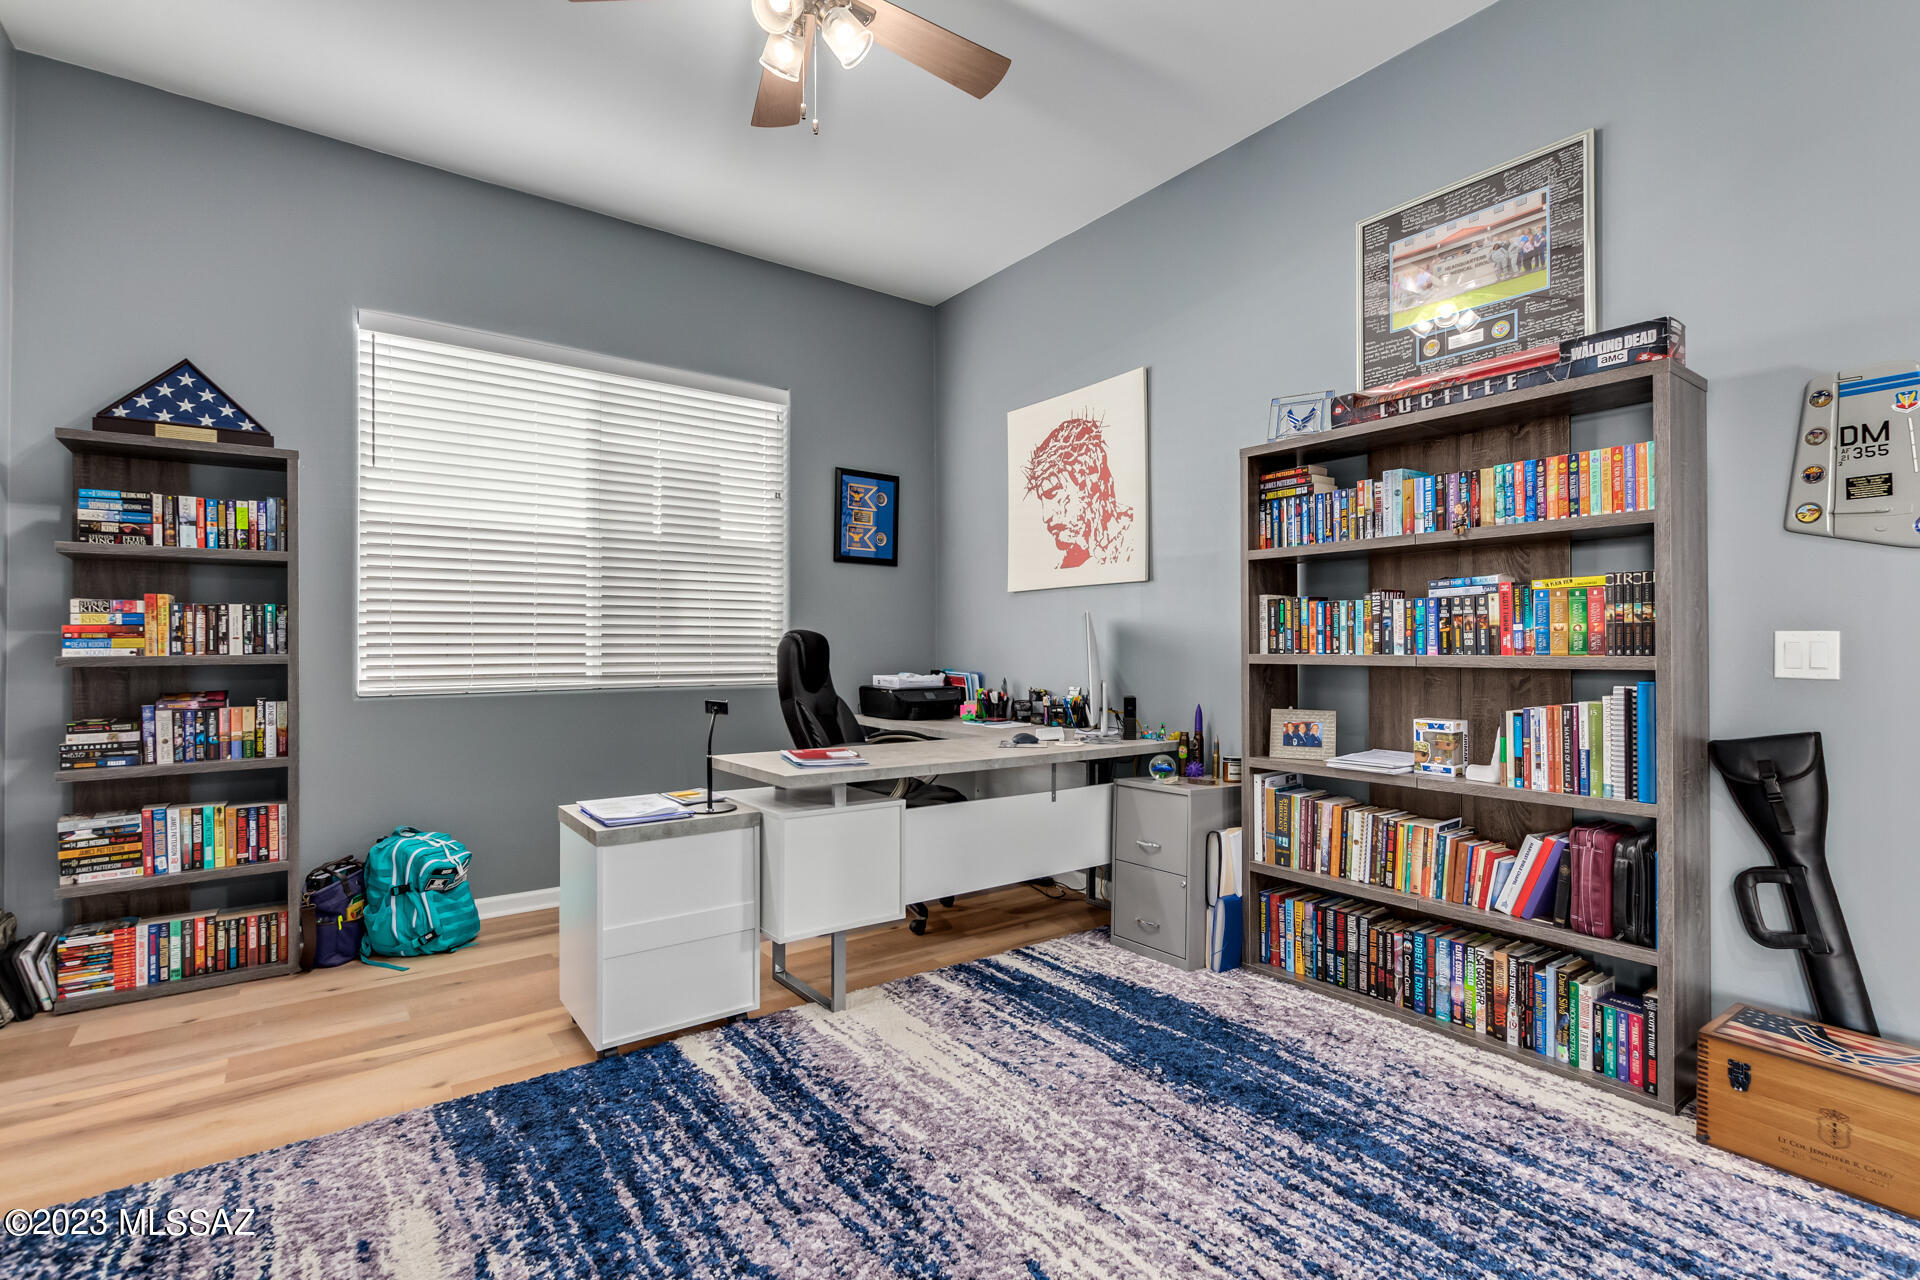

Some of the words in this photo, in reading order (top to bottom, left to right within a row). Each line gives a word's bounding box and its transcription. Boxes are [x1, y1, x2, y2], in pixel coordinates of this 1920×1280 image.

[1571, 337, 1623, 361] WALKING
[1624, 329, 1657, 348] DEAD
[1380, 373, 1517, 418] LUCILLE
[1840, 420, 1889, 447] DM
[1852, 444, 1889, 459] 355
[1561, 578, 1573, 586] VIEW
[1605, 571, 1656, 586] CIRCL
[80, 605, 110, 613] KING
[1372, 595, 1381, 615] SILVA
[170, 815, 178, 831] JAMES
[170, 831, 178, 857] PATTERSON
[1524, 842, 1534, 860] HARVEST
[75, 865, 92, 874] JAMES
[93, 863, 122, 871] PATTERSON
[1512, 870, 1522, 886] CHAPEL
[1415, 936, 1423, 970] ROBERT
[1439, 941, 1447, 958] CLIVE
[1476, 950, 1485, 966] LISA
[1439, 959, 1447, 986] CUSSLER
[1455, 961, 1463, 985] CUSSLER
[1495, 960, 1505, 975] JAMES
[1509, 957, 1517, 976] JAMES
[1415, 976, 1423, 1001] CRAIS
[1476, 967, 1485, 1005] GARDNER
[1495, 975, 1504, 1000] PATTERSON
[1509, 976, 1517, 1009] PATTERSON
[1558, 973, 1567, 996] Daniel
[1465, 989, 1473, 1019] MIRAGE
[1558, 997, 1568, 1015] Silva
[1495, 1003, 1506, 1027] CROSS
[1648, 1011, 1656, 1031] SCOTT
[1648, 1031, 1656, 1059] TUROW
[1809, 1146, 1851, 1166] JENNIFER
